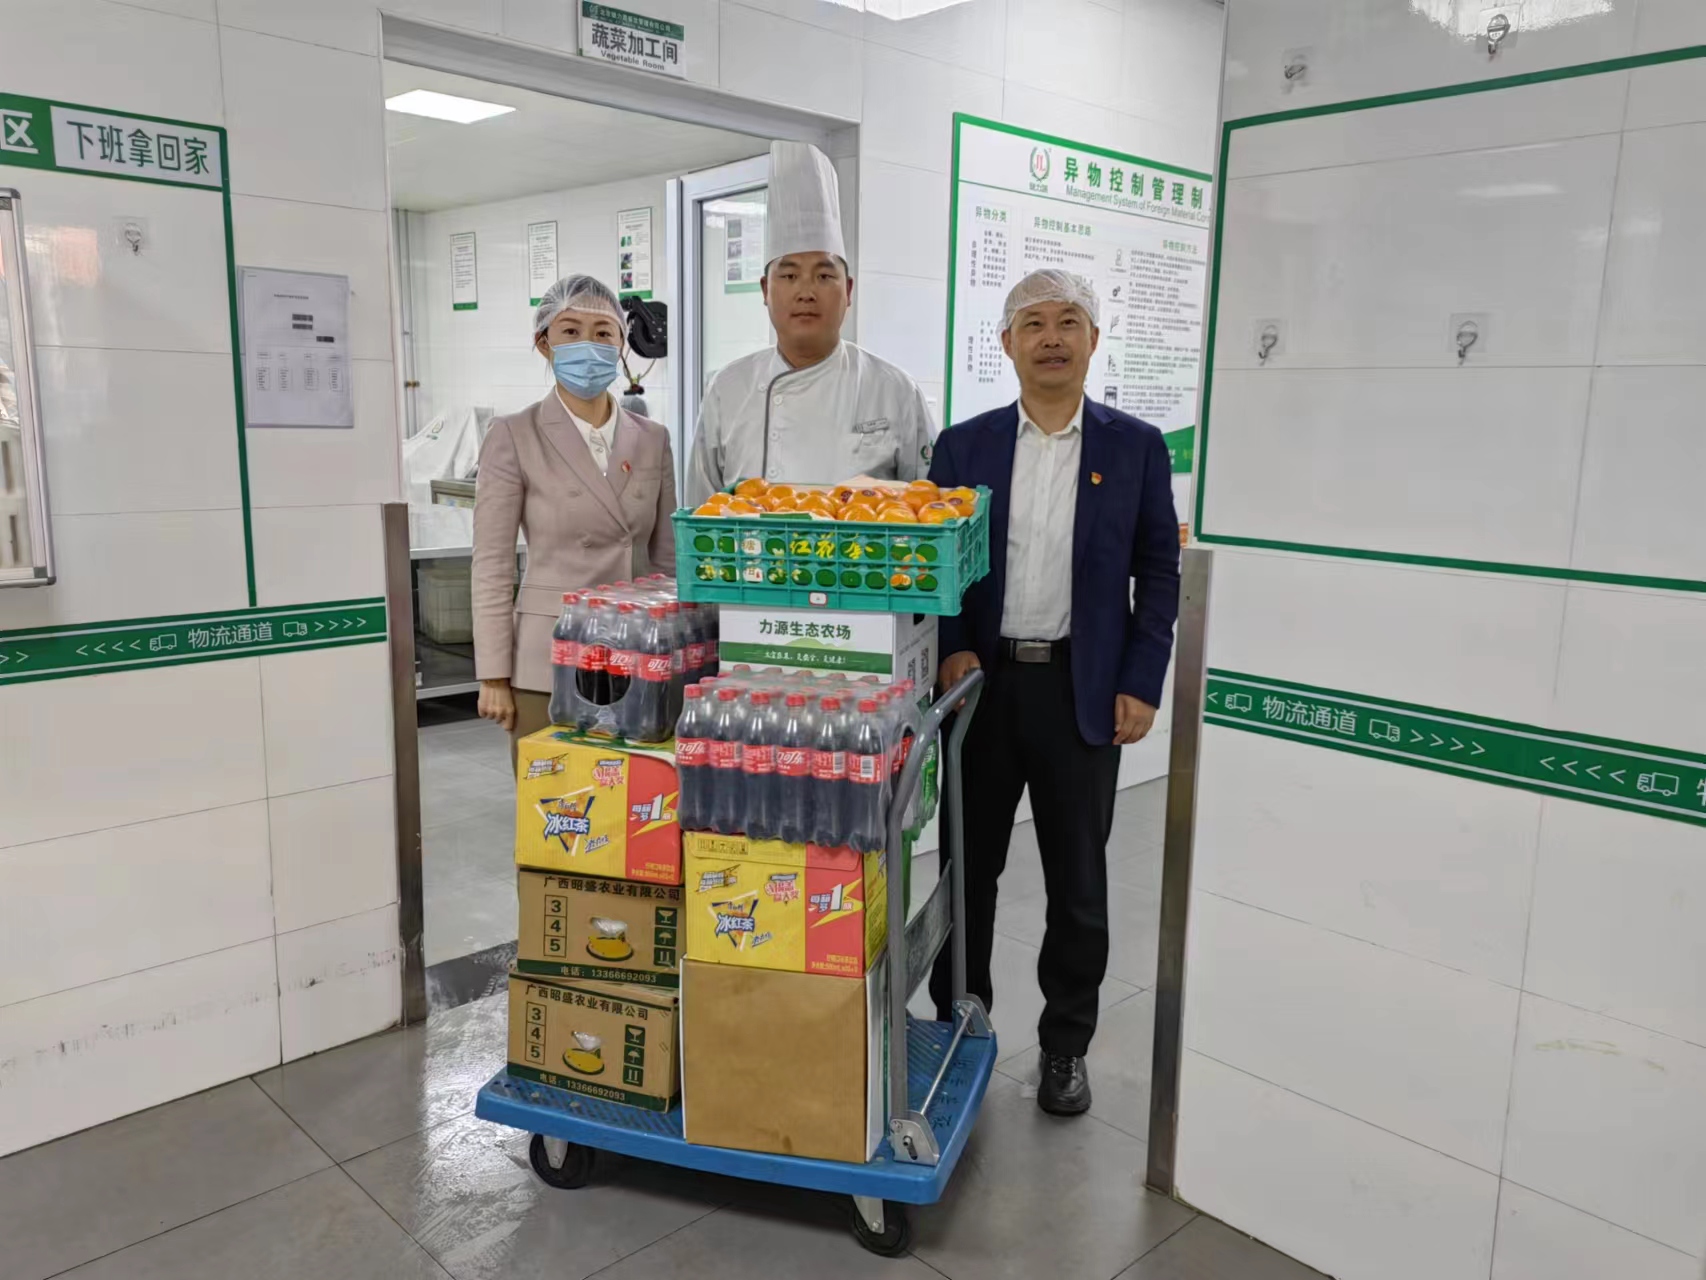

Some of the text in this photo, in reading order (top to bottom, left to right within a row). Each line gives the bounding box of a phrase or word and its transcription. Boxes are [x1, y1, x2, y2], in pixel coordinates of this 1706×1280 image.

[592, 22, 678, 65] 蔬菜加工间
[601, 50, 665, 71] Vegetable Room
[0, 108, 39, 154] 区
[66, 120, 209, 174] 下班拿回家
[1064, 156, 1211, 211] 异物控制管理制
[1065, 184, 1112, 204] Management
[1113, 195, 1139, 208] System
[1147, 202, 1171, 217] Foreign
[975, 206, 1007, 223] 异物分类
[1034, 216, 1092, 237] 异物控制基本思路
[187, 622, 273, 649] 物流通道
[760, 619, 851, 640] 力源生态农场
[1262, 694, 1358, 735] 物流通道
[545, 812, 589, 836] 冰红茶
[544, 876, 680, 901] 广西昭盛农业有限公司
[551, 900, 562, 913] 3
[550, 920, 562, 933] 4
[715, 913, 755, 935] 冰红茶
[550, 938, 561, 952] 5
[592, 969, 657, 983] 13366692093
[525, 984, 649, 1021] 广西昭盛农业有限公司
[531, 1007, 542, 1021] 3
[530, 1027, 541, 1040] 4
[530, 1046, 541, 1059] 5
[566, 1079, 626, 1101] 13366692093
